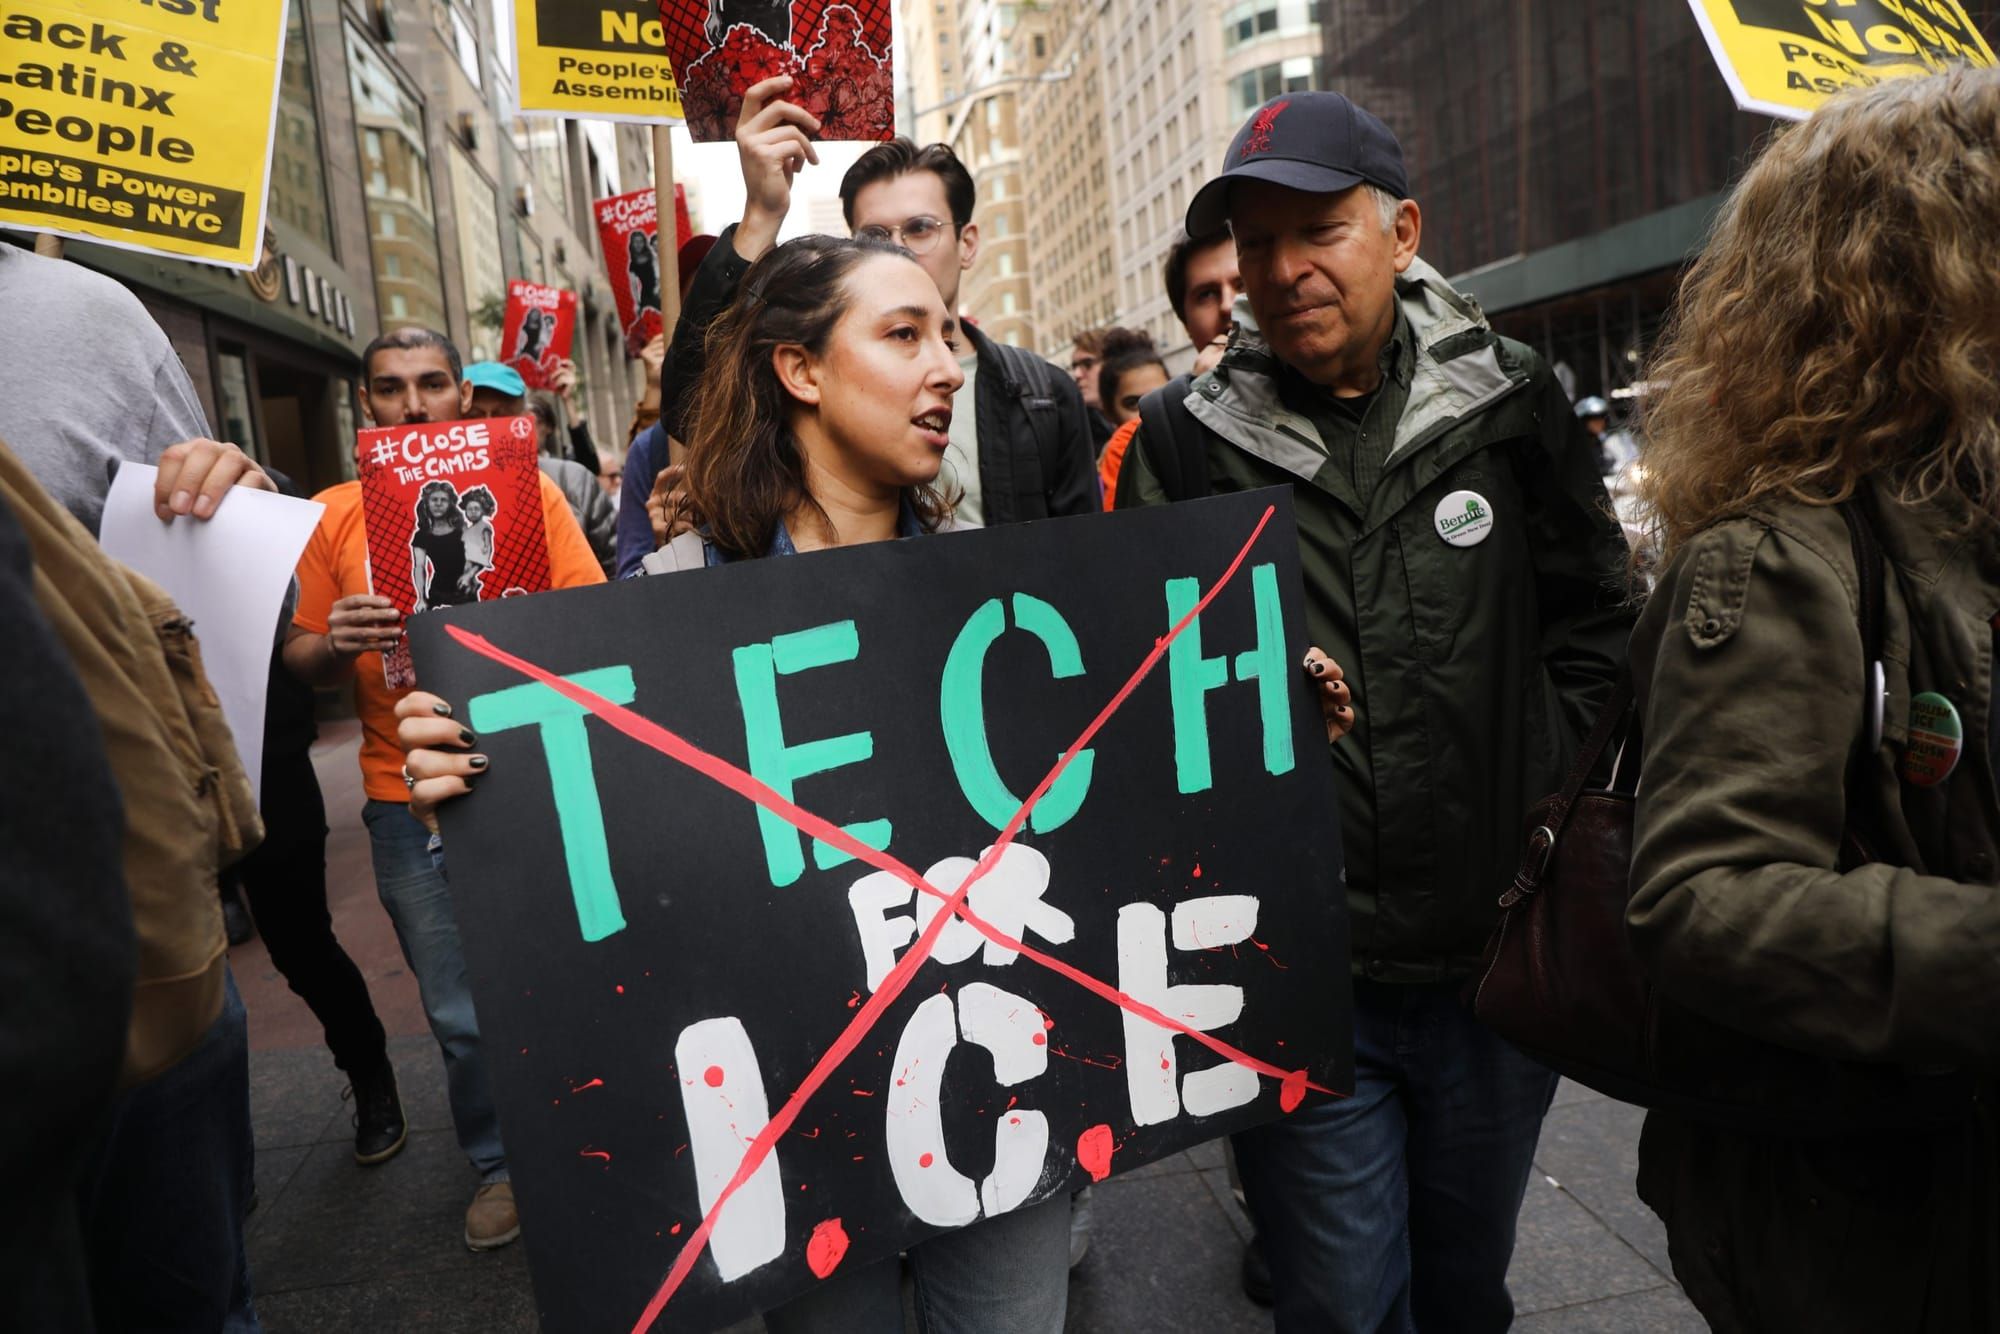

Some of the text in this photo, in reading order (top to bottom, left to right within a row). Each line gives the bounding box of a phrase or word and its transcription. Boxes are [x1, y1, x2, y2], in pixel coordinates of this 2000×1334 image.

[601, 10, 666, 47] No
[152, 41, 199, 78] &
[558, 56, 674, 80] People's
[0, 62, 176, 117] atinx
[552, 78, 680, 104] Assembli
[97, 168, 217, 209] Power
[147, 203, 223, 235] NYC
[370, 423, 490, 466] #CLOSE
[393, 448, 490, 486] THE CAMPS
[1439, 506, 1485, 530] Bernie
[469, 563, 1294, 943] TECH
[848, 842, 1075, 994] FOR
